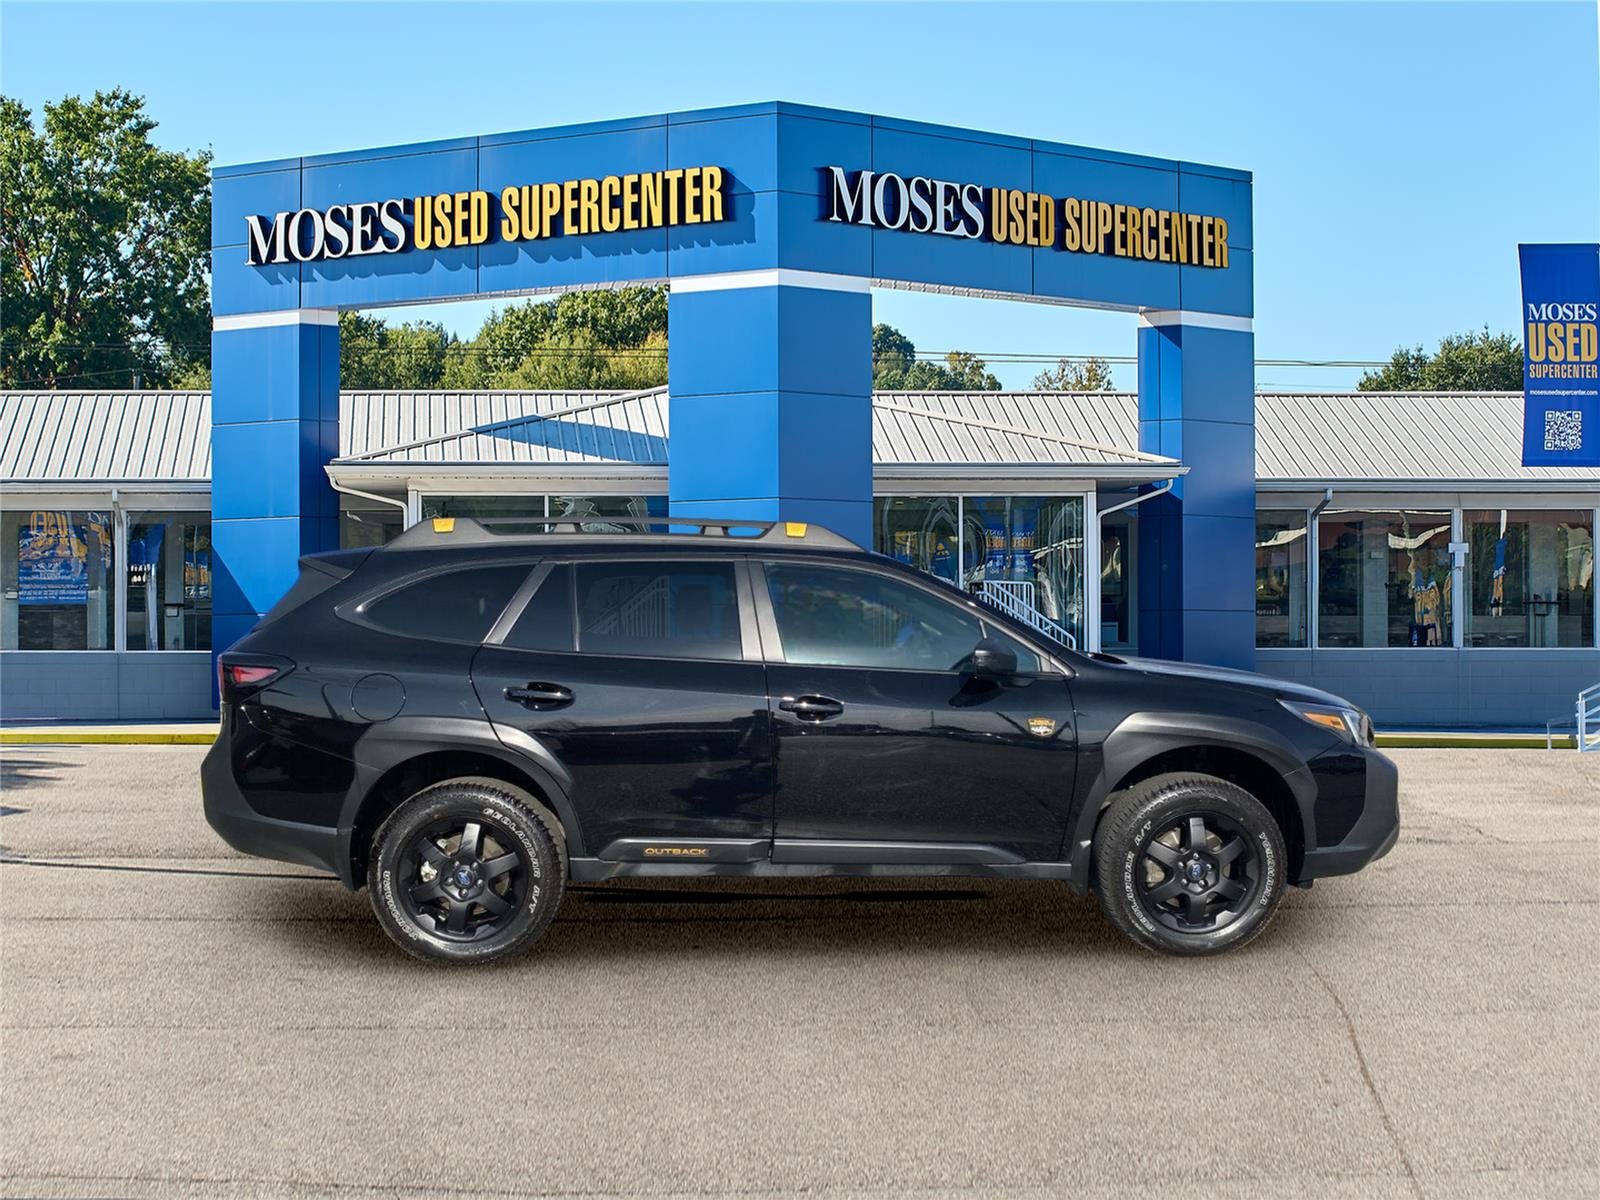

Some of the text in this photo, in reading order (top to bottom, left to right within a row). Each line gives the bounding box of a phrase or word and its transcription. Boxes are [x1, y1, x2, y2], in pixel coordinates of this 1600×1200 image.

[244, 166, 724, 266] MOSES USED SUPERCENTER
[828, 166, 1229, 268] MOSES USED SUPERCENTER
[1528, 303, 1598, 322] MOSES
[1528, 322, 1598, 362] USED
[1529, 364, 1598, 379] SUPERCENTER
[644, 847, 707, 856] OUTBACK
